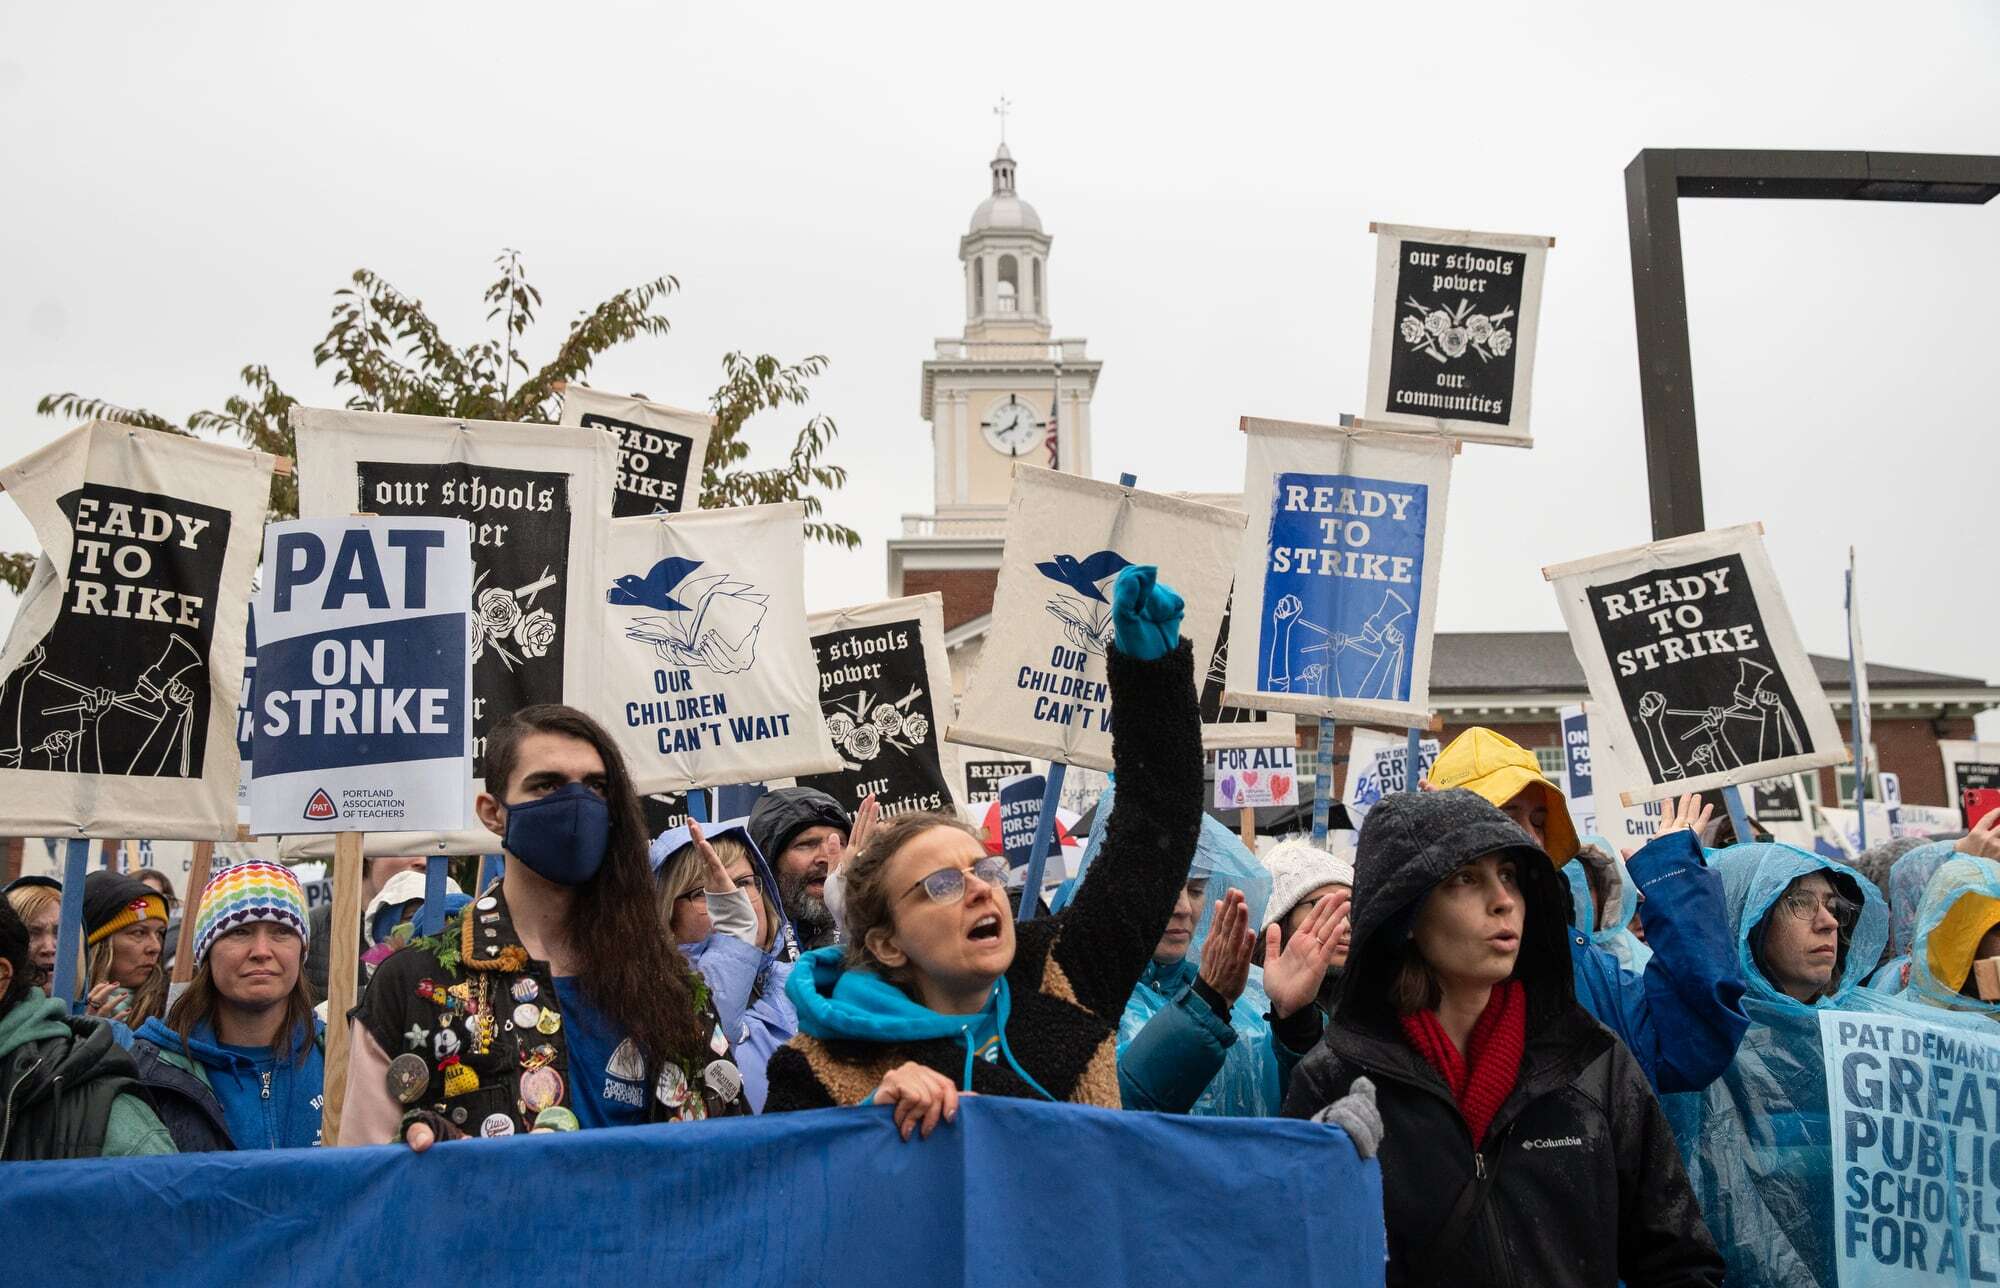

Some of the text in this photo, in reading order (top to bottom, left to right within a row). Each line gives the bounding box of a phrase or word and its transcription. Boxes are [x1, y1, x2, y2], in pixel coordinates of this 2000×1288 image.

[1409, 251, 1514, 275] our schools
[1432, 274, 1487, 293] power
[1437, 372, 1465, 389] our
[1396, 390, 1503, 414] communities
[617, 449, 649, 472] TO
[375, 477, 555, 512] our schools
[616, 470, 677, 501] RIKE
[1284, 485, 1412, 520] READY
[76, 498, 210, 550] EADY
[1320, 518, 1371, 547] TO
[77, 539, 152, 579] TO
[273, 529, 445, 613] PAT
[1273, 546, 1413, 584] STRIKE
[67, 577, 203, 629] RIKE
[1601, 567, 1730, 621] READY
[1648, 604, 1703, 635] TO
[830, 630, 909, 661] schools
[1616, 624, 1759, 677] STRIKE
[311, 639, 385, 686] ON
[1051, 645, 1088, 672] OUR
[654, 669, 693, 694] OUR
[820, 662, 882, 692] power
[1017, 666, 1107, 703] CHILDREN
[263, 688, 449, 737] STRIKE
[625, 693, 727, 727] CHILDREN
[1034, 696, 1094, 729] CAN'T
[657, 714, 790, 755] CAN'T WAIT
[1567, 730, 1588, 745] ON
[1218, 747, 1292, 770] FOR ALL
[1375, 744, 1436, 760] PAT DEDS
[1572, 747, 1590, 760] FO
[970, 765, 1026, 778] READY
[1378, 753, 1437, 777] GRAT
[343, 789, 393, 798] PORTLAND
[856, 777, 889, 798] our
[987, 779, 998, 790] T
[312, 803, 328, 812] PAT
[343, 800, 404, 808] ASSOCIATION
[970, 792, 998, 802] STR
[1000, 803, 1011, 818] ON
[1012, 799, 1043, 815] STRI
[1644, 802, 1662, 816] OU
[343, 809, 405, 818] OF TEACHERS
[668, 814, 688, 828] ou
[1002, 817, 1039, 834] FOR SA
[1626, 819, 1660, 835] CHIL
[1004, 832, 1056, 850] SCHOS
[307, 884, 333, 907] PA
[1838, 1020, 2000, 1073] PAT DEMAND
[1534, 1136, 1582, 1148] Columbia
[1845, 1166, 2000, 1234] SCHOOL
[1845, 1210, 2000, 1283] FOR AL
